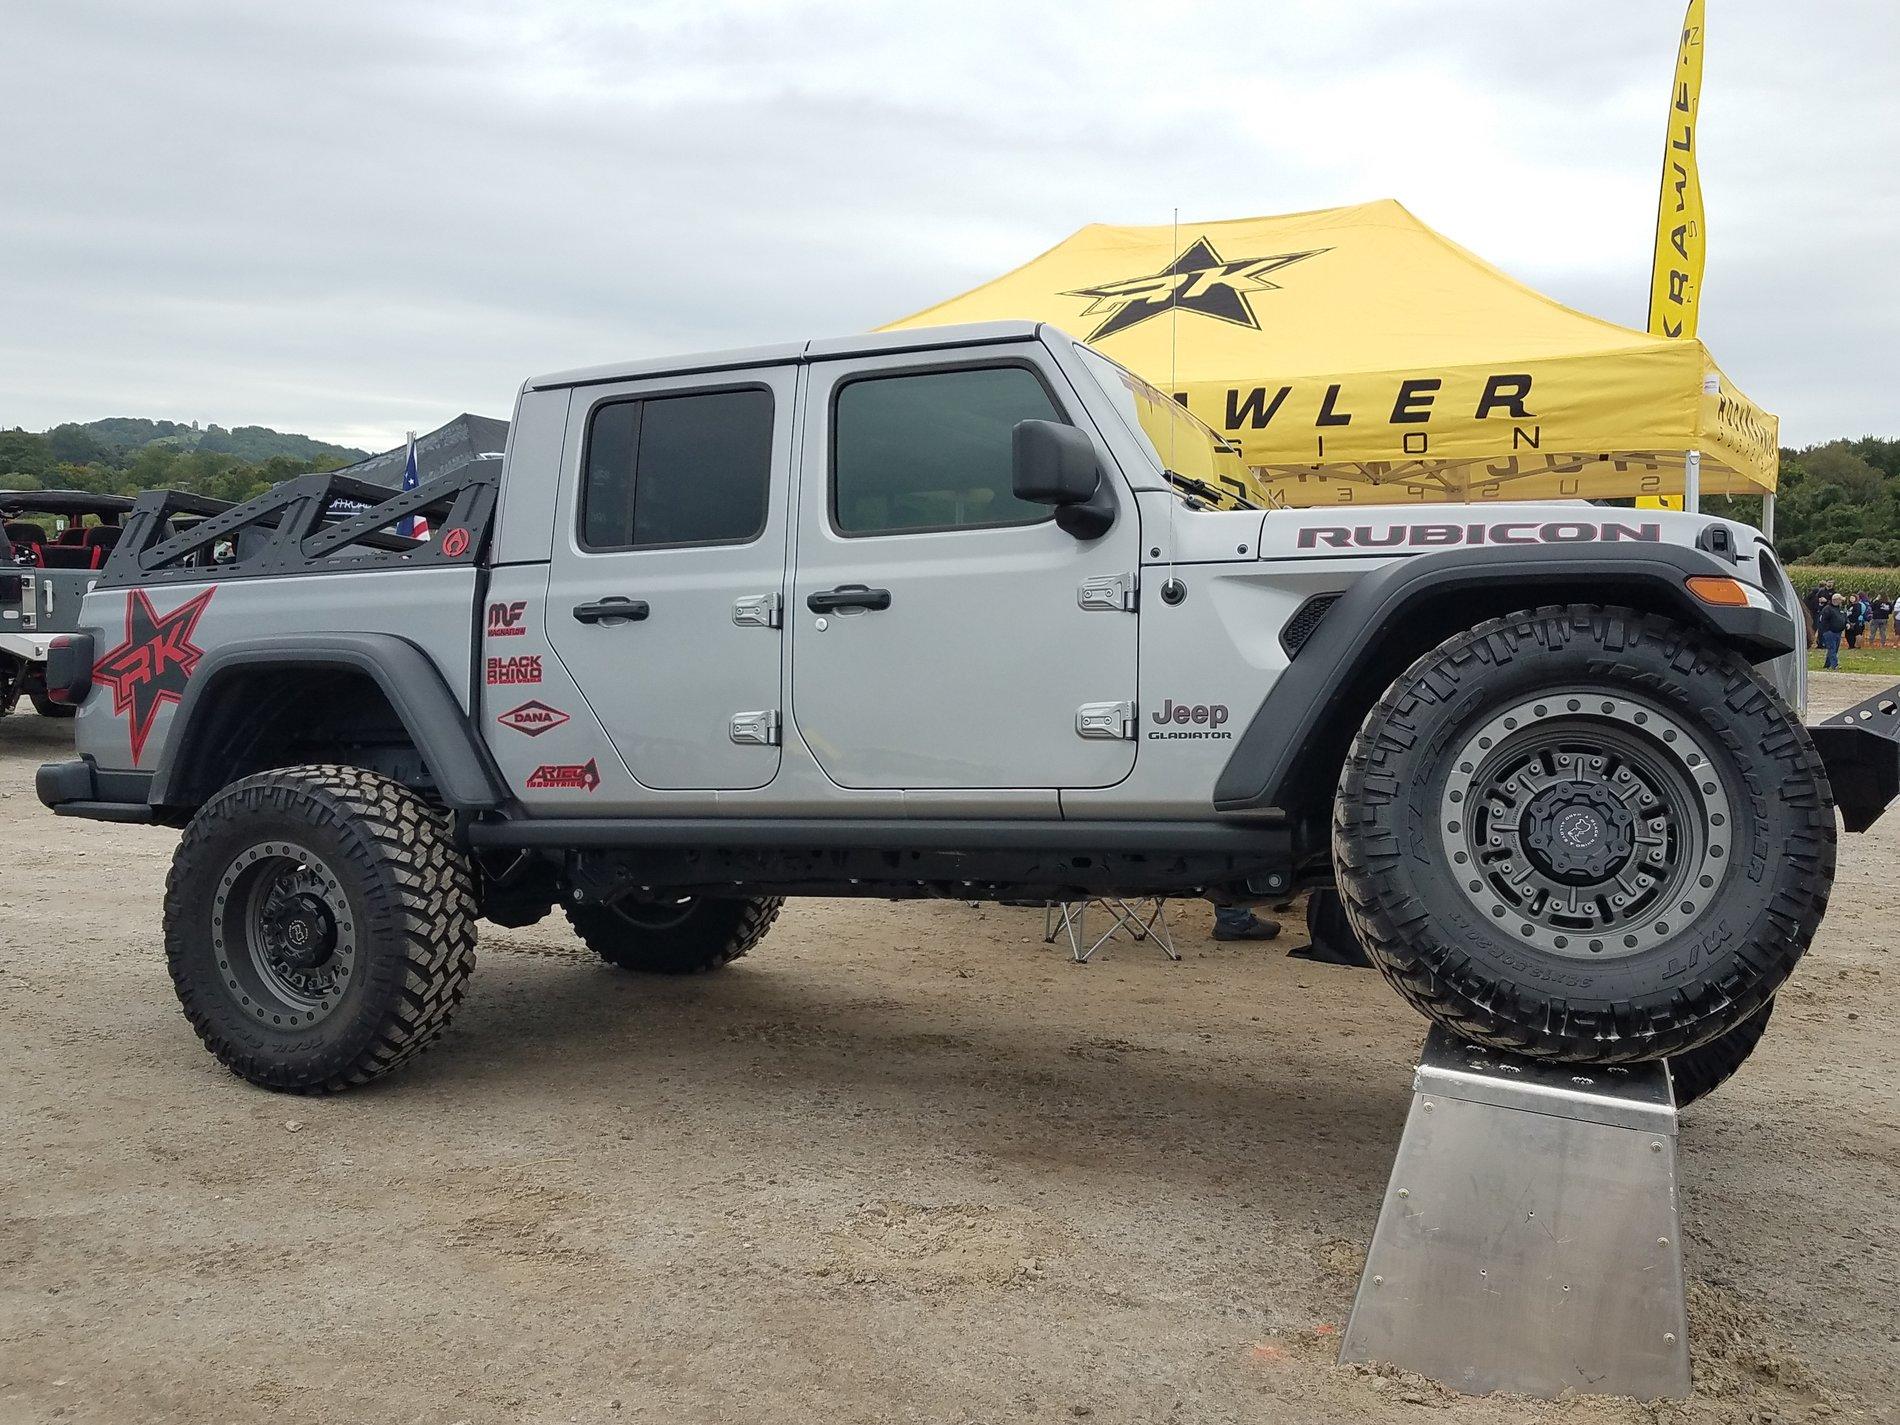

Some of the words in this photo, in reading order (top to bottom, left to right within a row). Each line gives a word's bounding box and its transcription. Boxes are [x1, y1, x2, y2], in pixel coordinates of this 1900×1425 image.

[1173, 374, 1537, 430] WLER
[1297, 523, 1661, 549] RUBICON
[487, 655, 542, 668] BLACK
[487, 667, 542, 681] RHINO
[514, 712, 553, 722] DANA
[1152, 699, 1228, 728] Jeep
